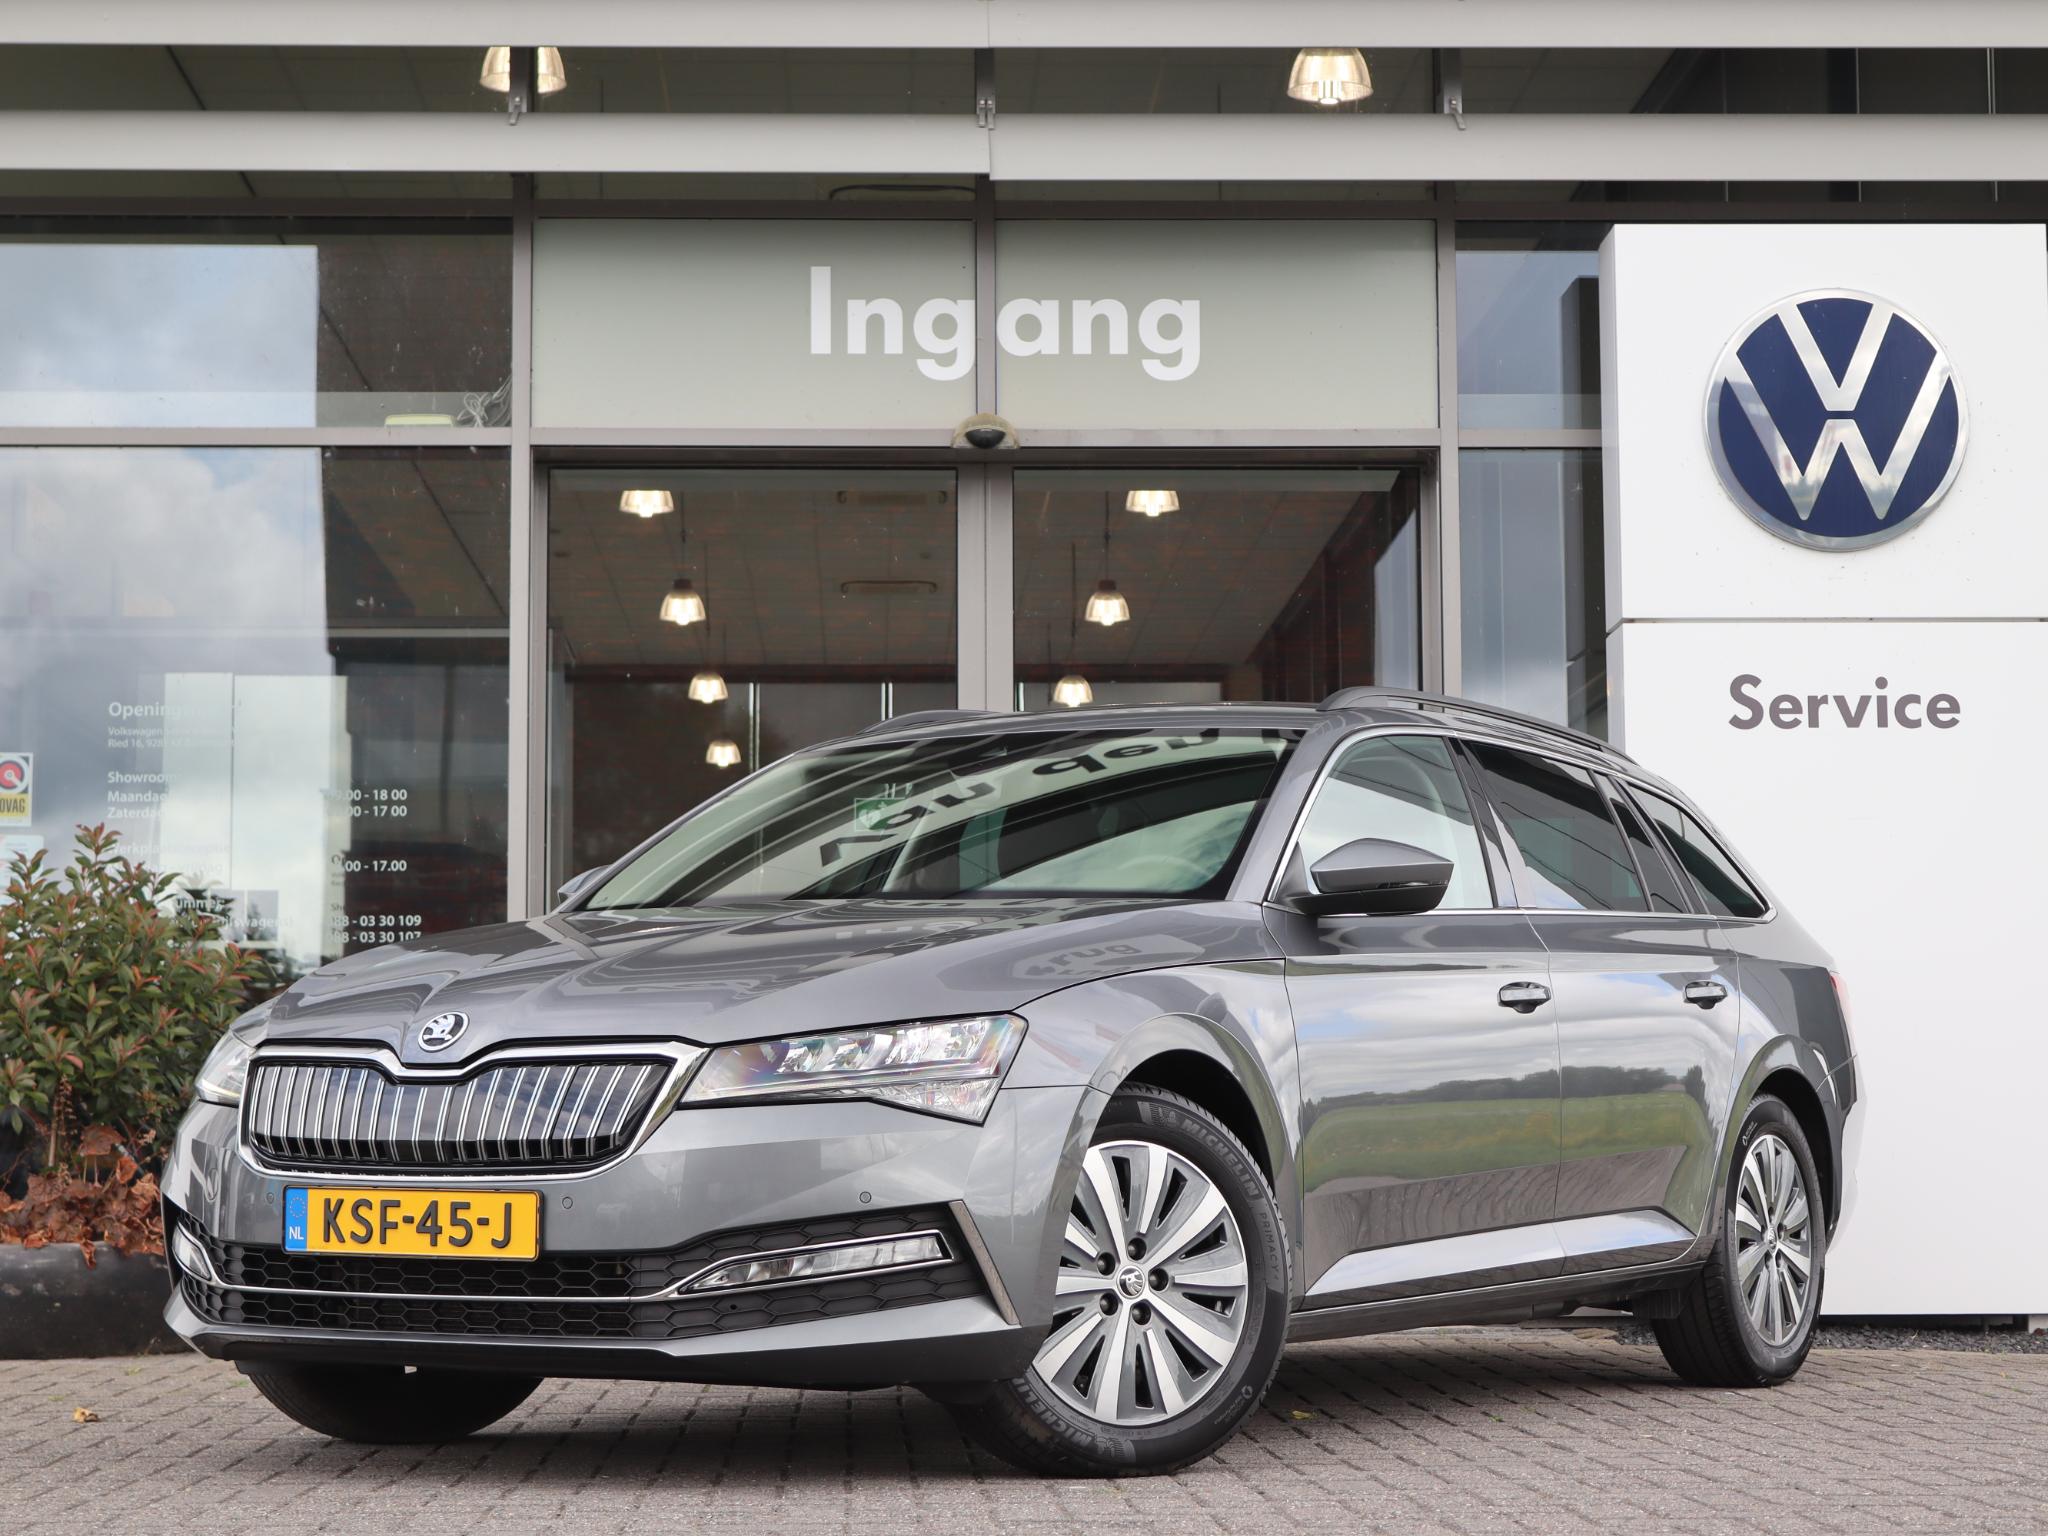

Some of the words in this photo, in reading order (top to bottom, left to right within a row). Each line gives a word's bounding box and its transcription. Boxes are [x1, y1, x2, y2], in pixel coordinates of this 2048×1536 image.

[811, 266, 1200, 381] Ingang
[1729, 674, 1961, 730] Service
[372, 860, 407, 872] 17.00
[360, 915, 376, 927] 03
[379, 915, 395, 927] 30
[398, 915, 422, 927] 109
[360, 931, 376, 943] 03
[379, 931, 395, 943] 30
[1180, 1117, 1261, 1200] MICHELIN
[288, 1226, 304, 1241] NL
[323, 1198, 513, 1249] KSF-45-J
